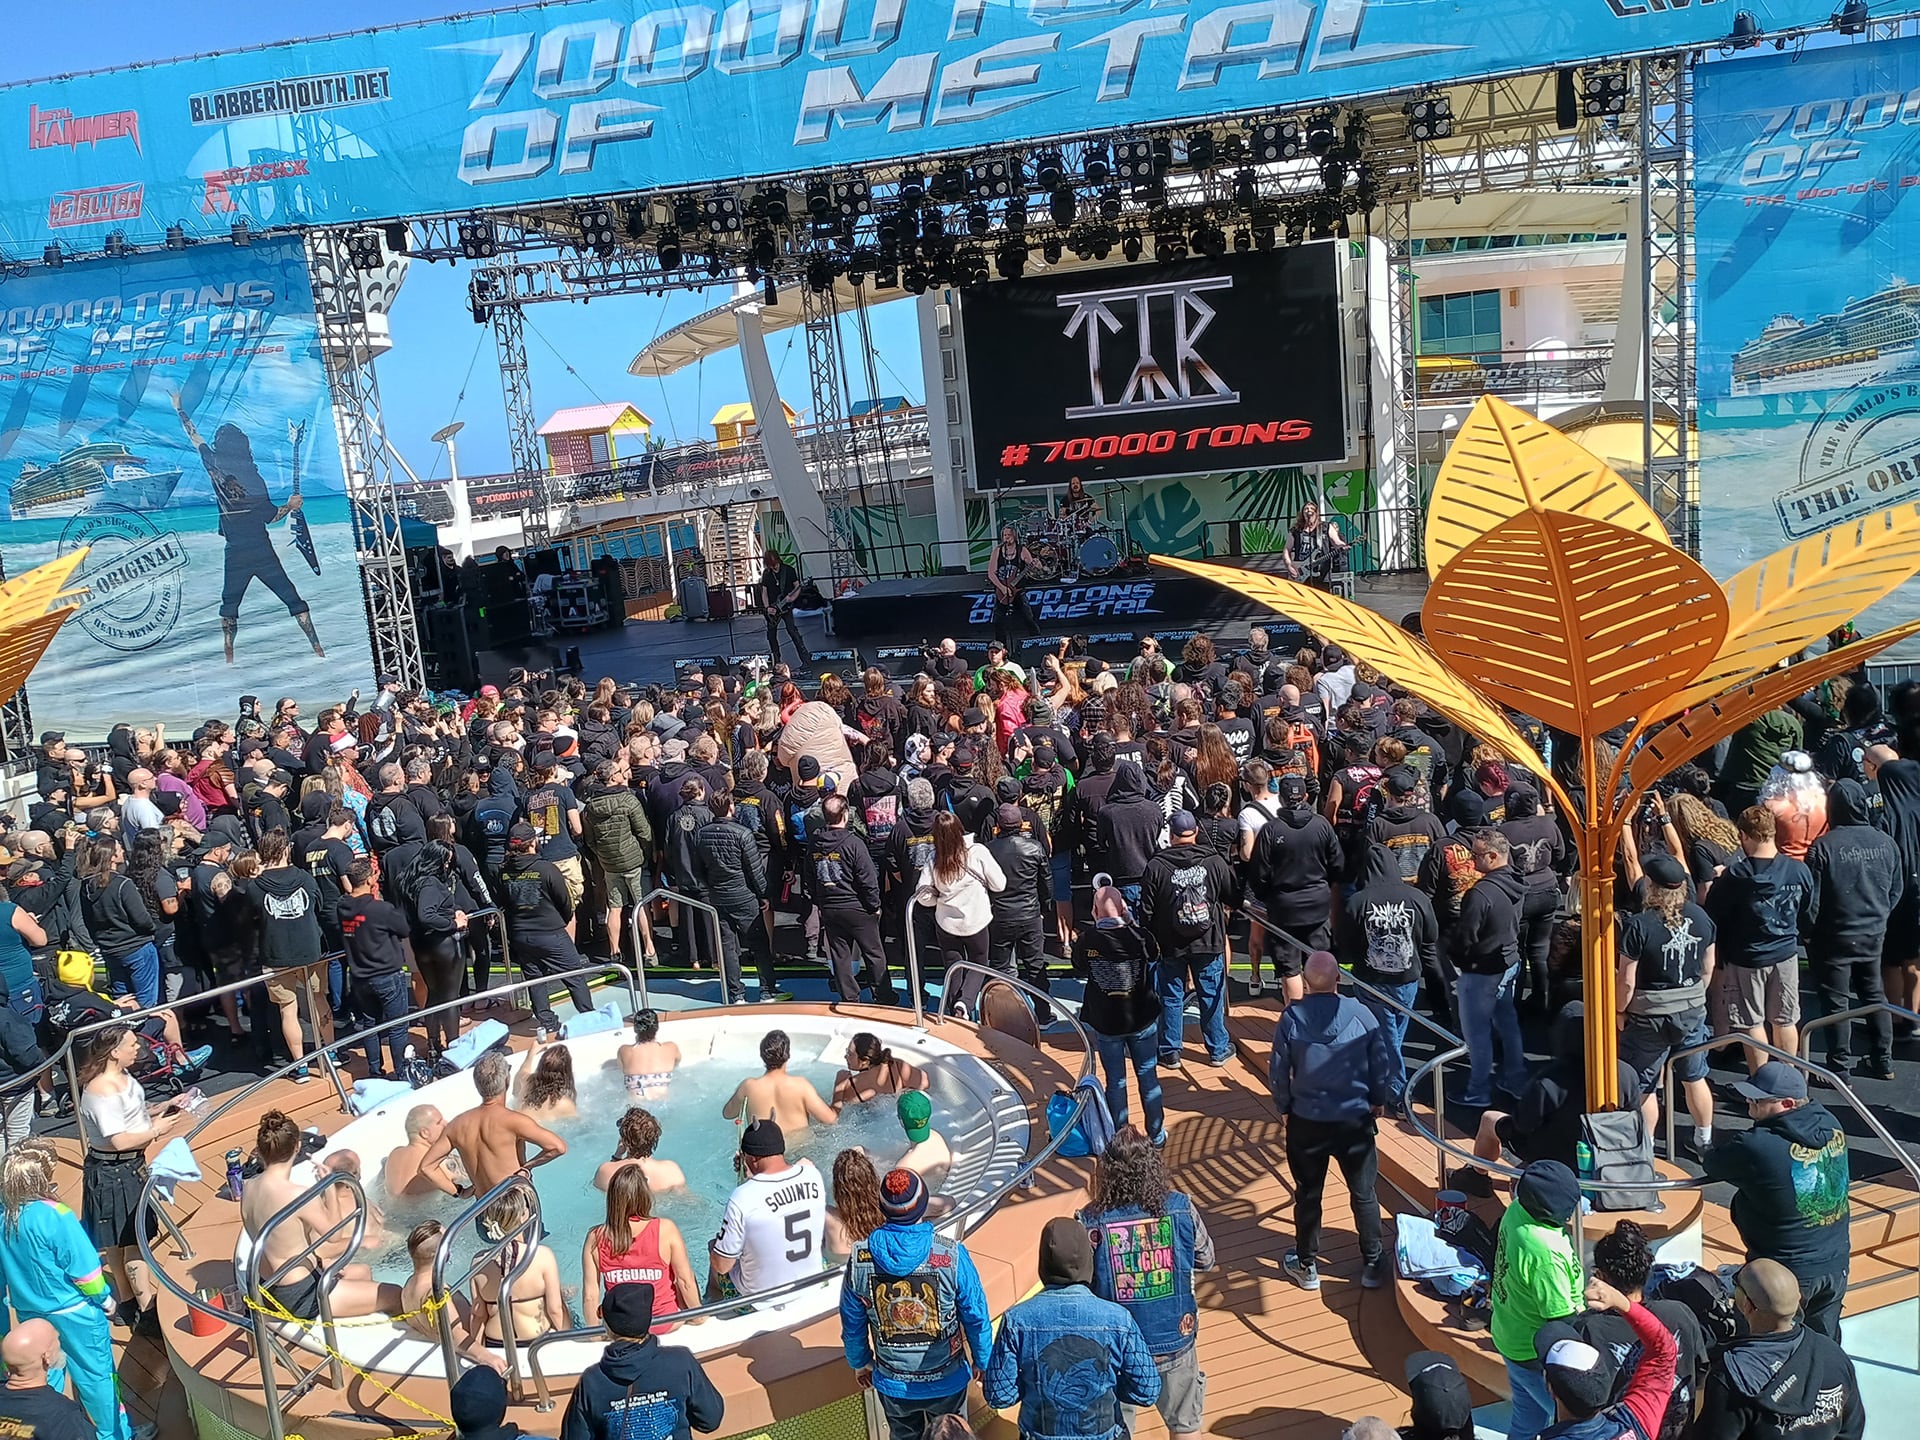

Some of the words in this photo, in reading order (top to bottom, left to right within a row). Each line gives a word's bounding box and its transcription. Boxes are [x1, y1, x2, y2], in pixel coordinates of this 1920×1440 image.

[190, 70, 390, 124] BLABBERMOUTH.NET
[457, 98, 664, 186] OF
[794, 0, 1476, 147] METAL
[29, 104, 143, 160] HAMMER
[1740, 138, 1868, 186] OF
[1797, 179, 1889, 201] World's
[128, 280, 275, 322] TONS
[91, 309, 296, 357] METAL
[20, 366, 67, 380] World's
[72, 361, 125, 374] Biggest
[131, 355, 177, 368] Heavy
[182, 349, 227, 362] Metal
[232, 344, 285, 357] Cruise
[1819, 436, 1841, 469] THE
[1834, 386, 1901, 433] WORLD'S
[1791, 479, 1860, 522] THE
[70, 519, 102, 550] WORLD'S
[104, 516, 146, 540] BIGGEST
[96, 543, 178, 594] ORIGINAL
[93, 618, 125, 638] HEAVY
[126, 621, 157, 639] METAL
[155, 584, 172, 622] CRUISE
[1039, 599, 1165, 621] METAL
[1063, 583, 1156, 601] TONS
[765, 1182, 819, 1212] SQUINTS
[784, 1209, 812, 1262] 5
[1109, 1217, 1172, 1256] BAD
[604, 1268, 662, 1282] LIFEGUARD
[1113, 1248, 1173, 1273] RELIGION
[1118, 1281, 1173, 1298] CONTROL
